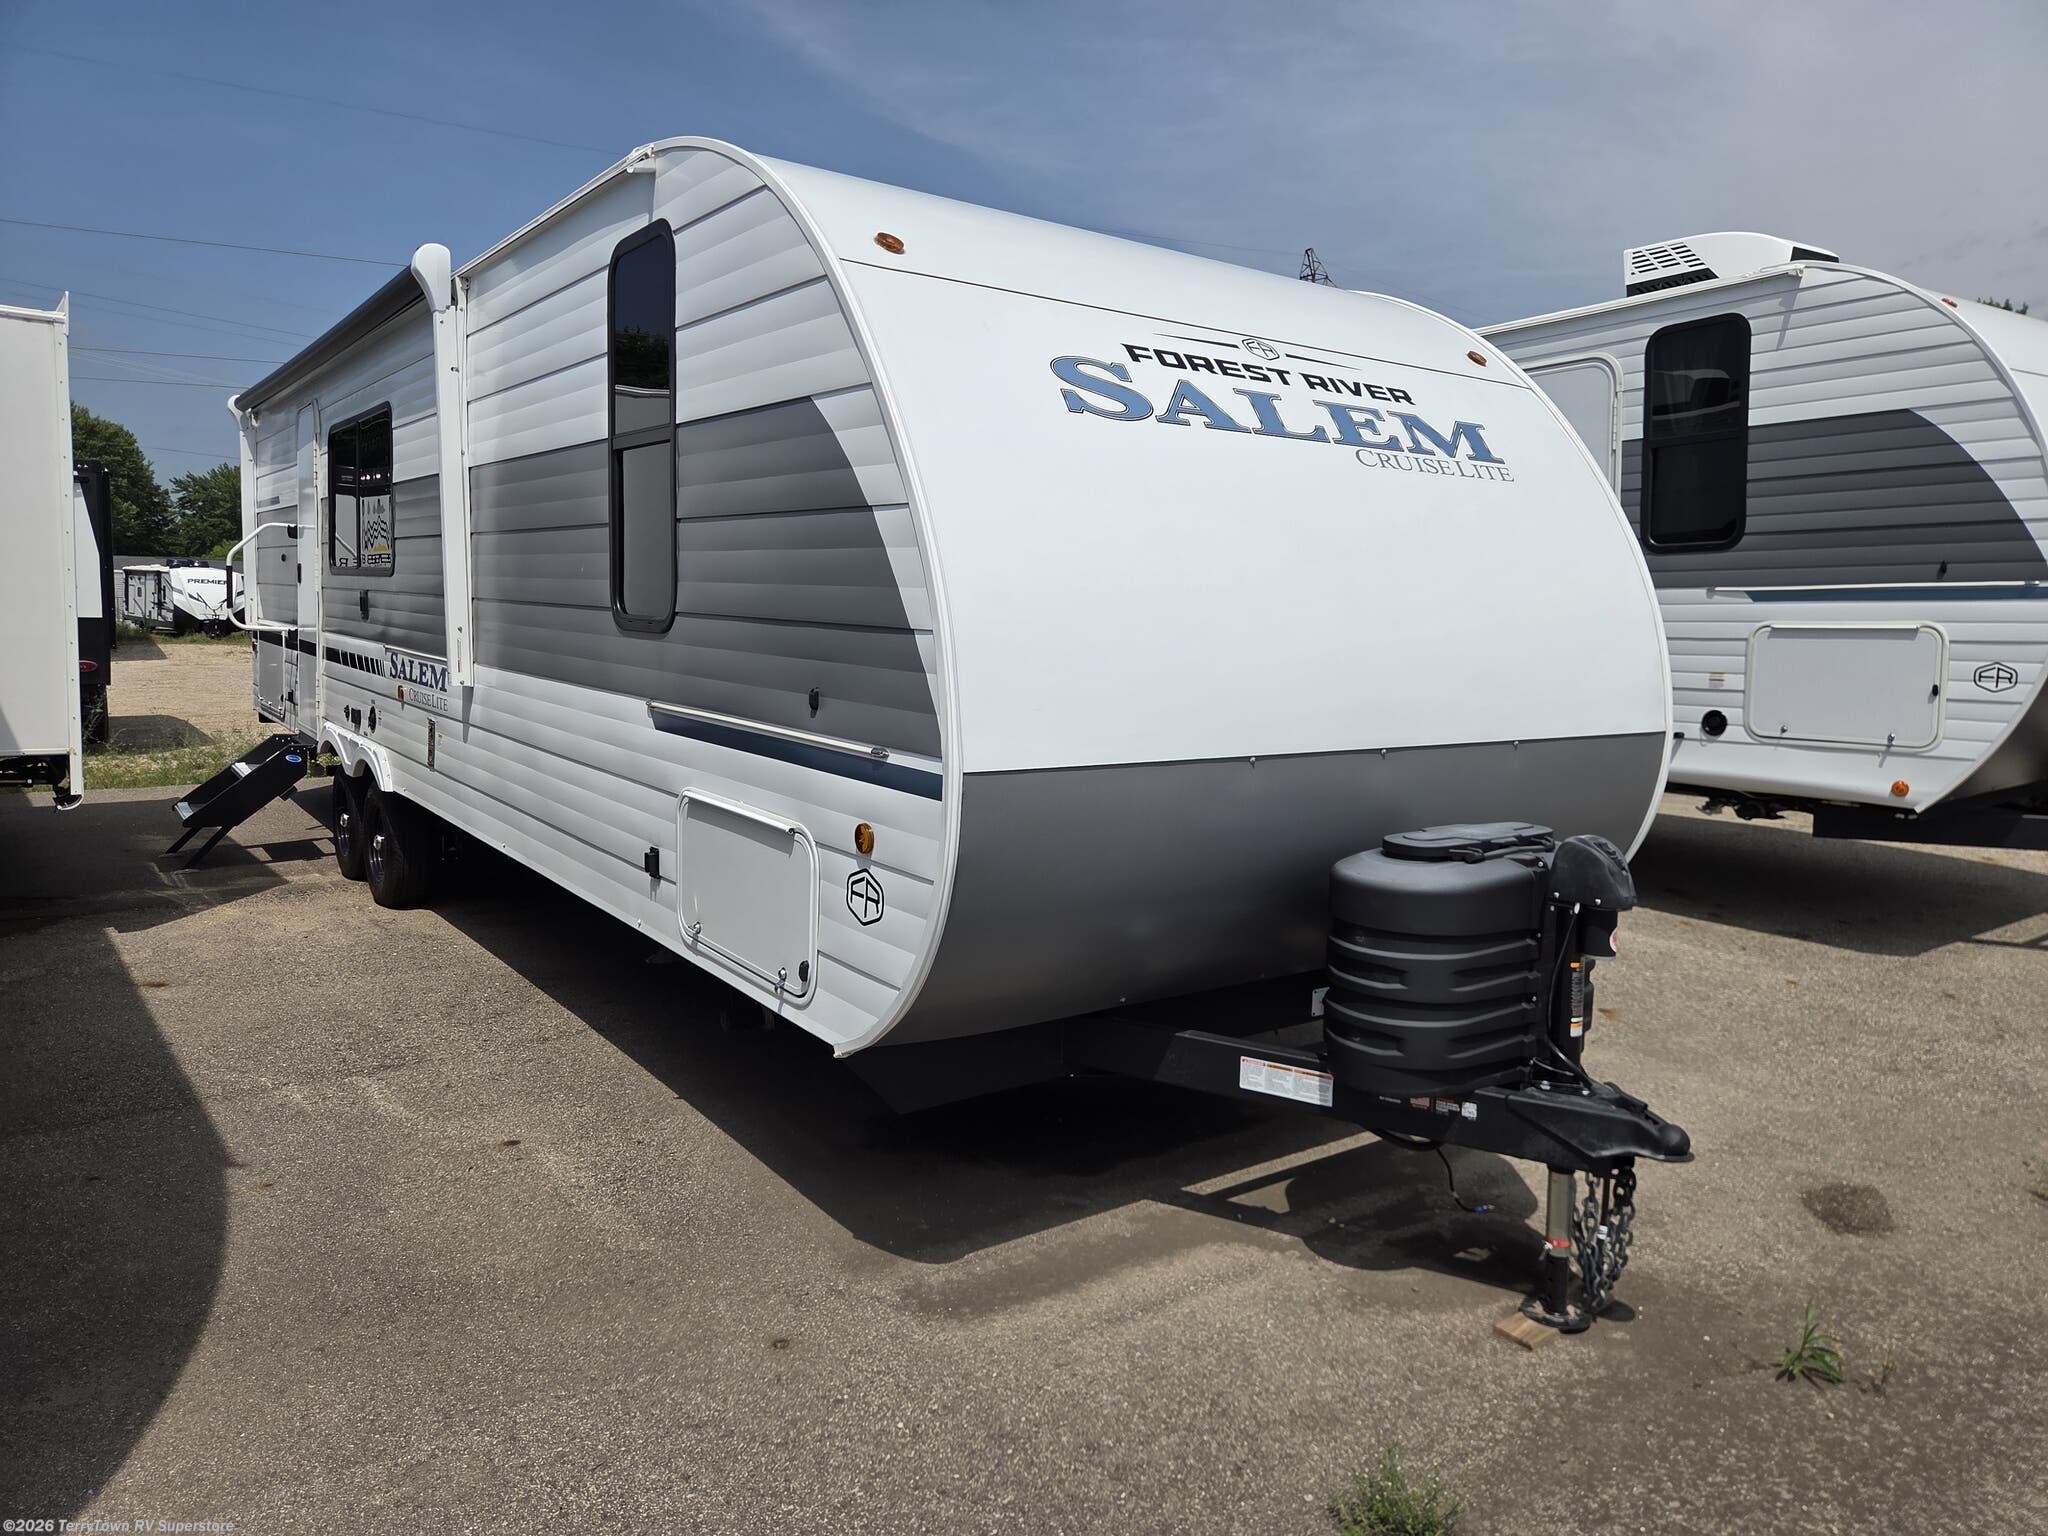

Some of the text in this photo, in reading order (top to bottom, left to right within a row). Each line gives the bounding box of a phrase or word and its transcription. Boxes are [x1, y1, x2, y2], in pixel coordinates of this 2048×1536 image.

[1120, 343, 1416, 406] FOREST RIVER
[1049, 355, 1506, 464] SALEM
[389, 651, 448, 693] SALEM
